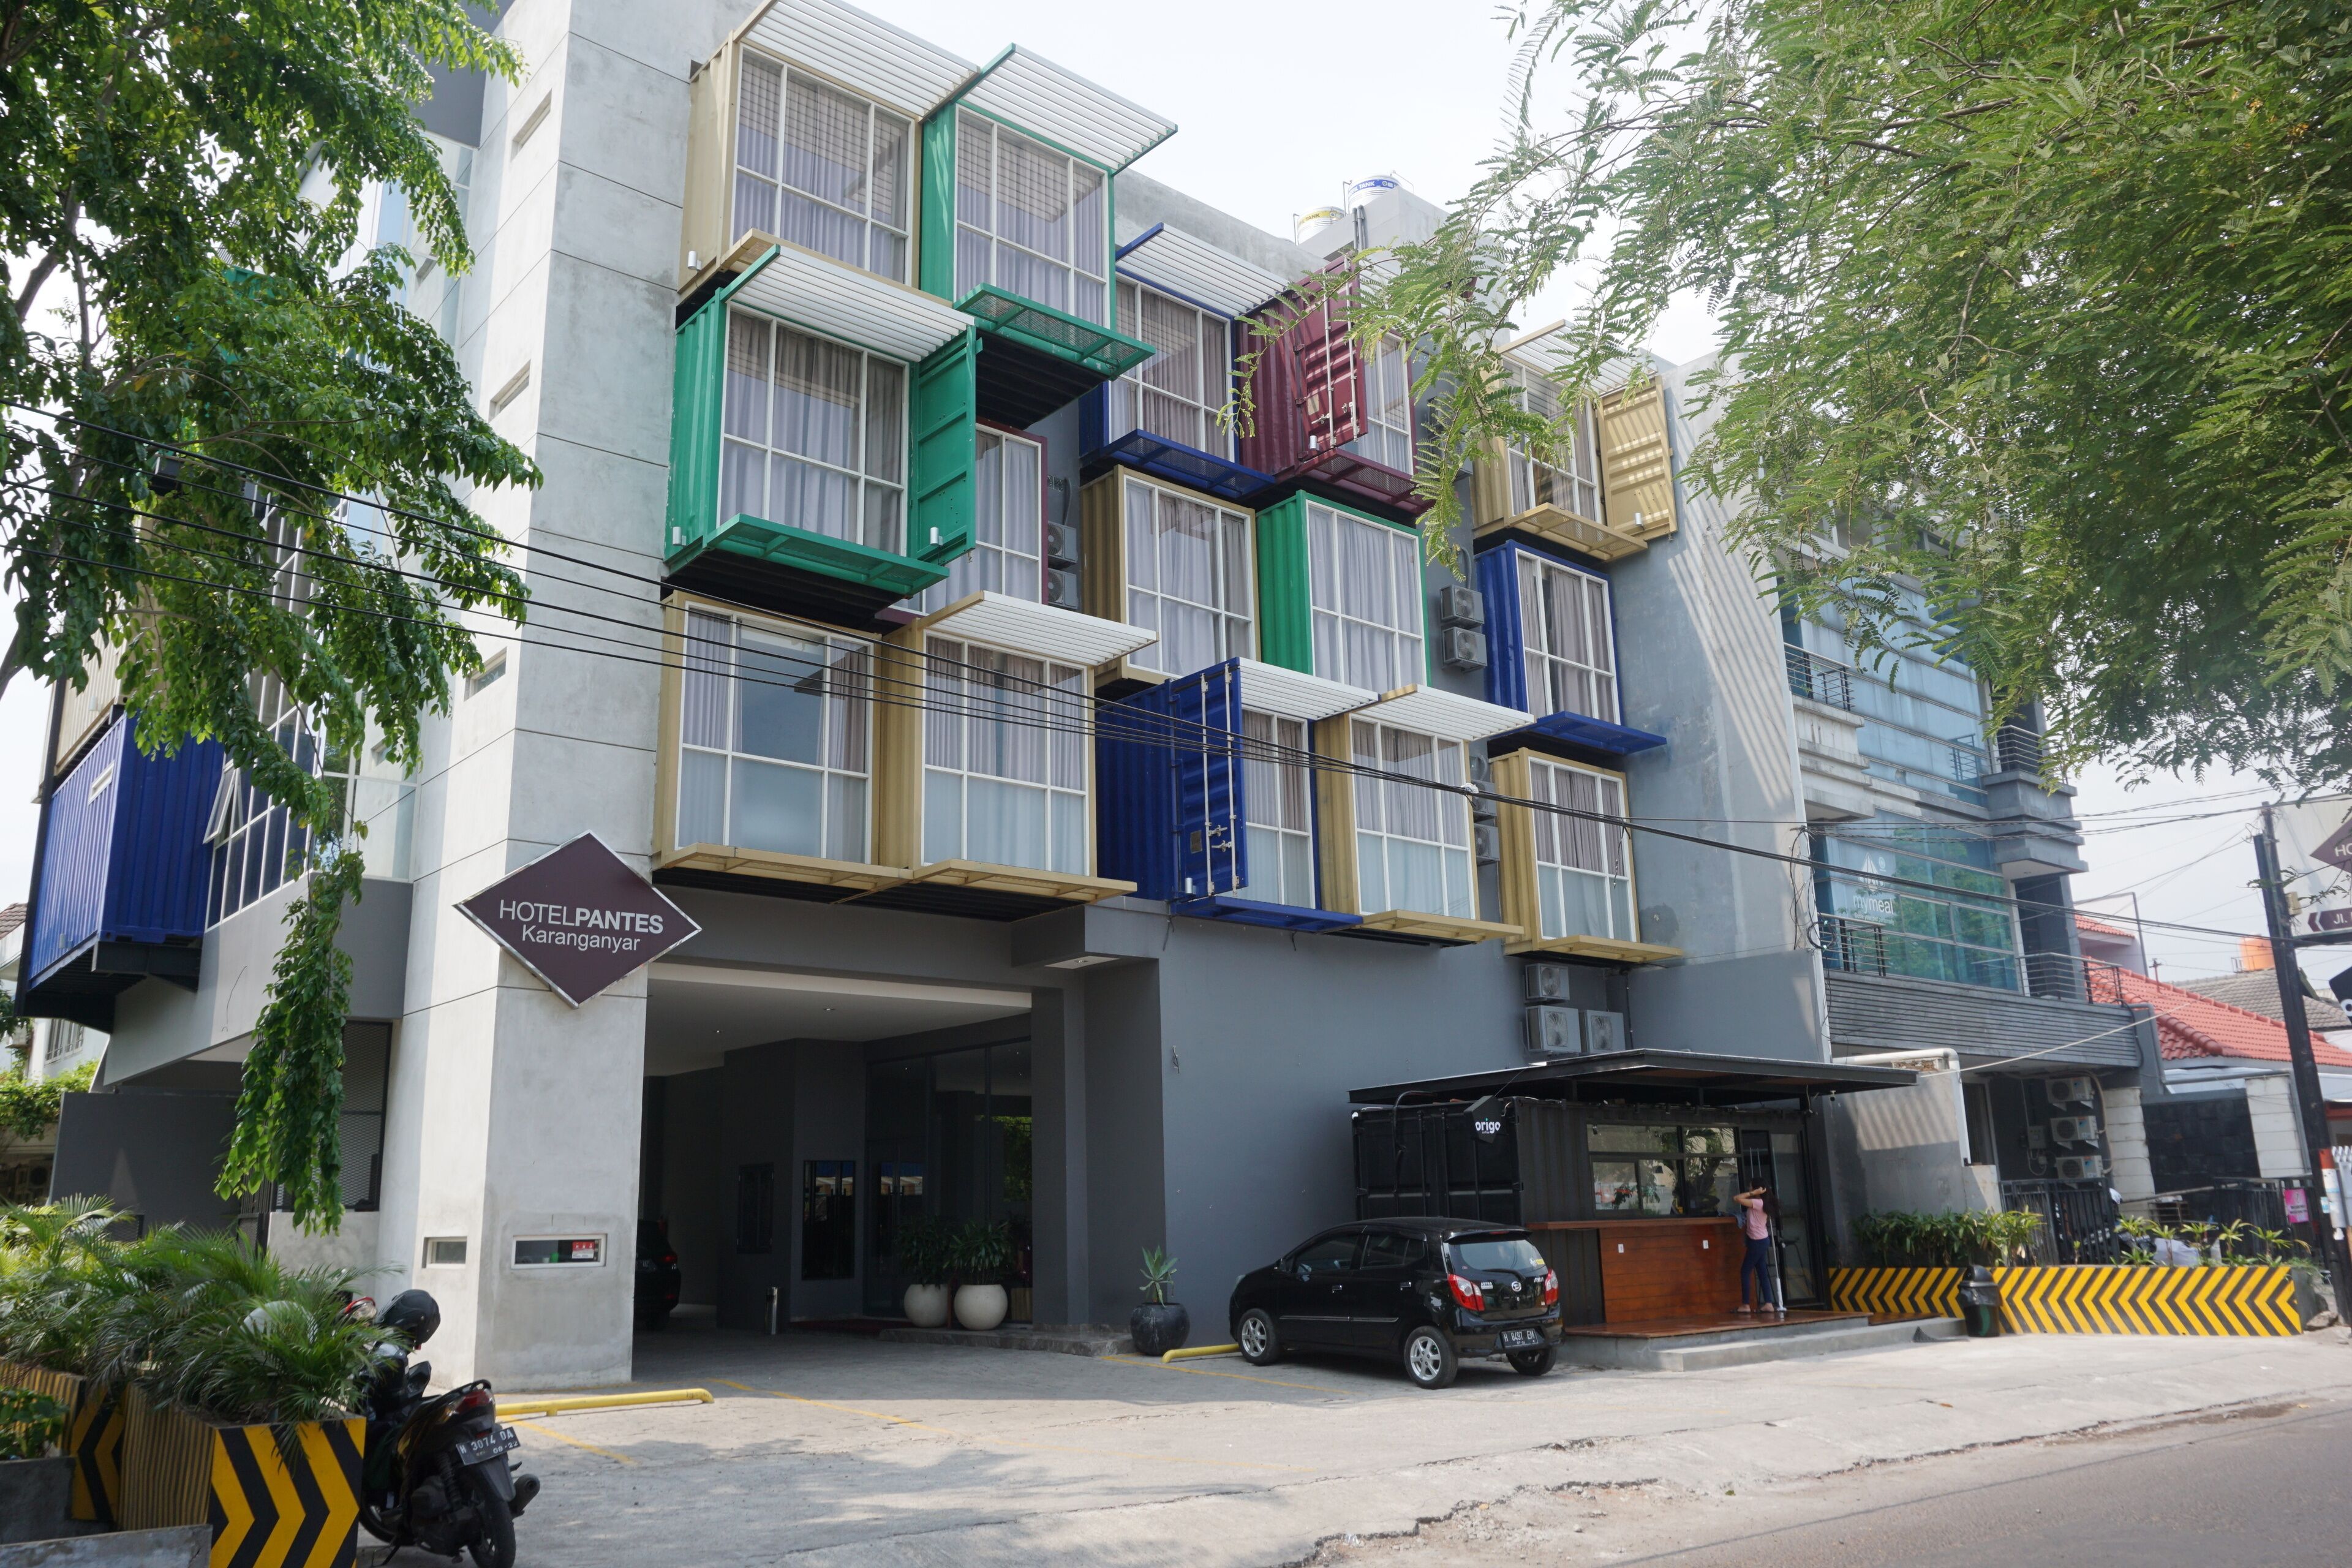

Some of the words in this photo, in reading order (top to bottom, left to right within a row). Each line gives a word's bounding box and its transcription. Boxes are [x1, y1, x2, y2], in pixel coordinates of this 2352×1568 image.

[522, 924, 641, 953] Karanganyar
[1475, 1118, 1501, 1134] origo
[1503, 1333, 1509, 1342] H
[1510, 1331, 1523, 1341] 8497
[1526, 1330, 1535, 1340] EM
[459, 1445, 467, 1454] H
[470, 1434, 496, 1451] 3074
[499, 1429, 514, 1441] DA
